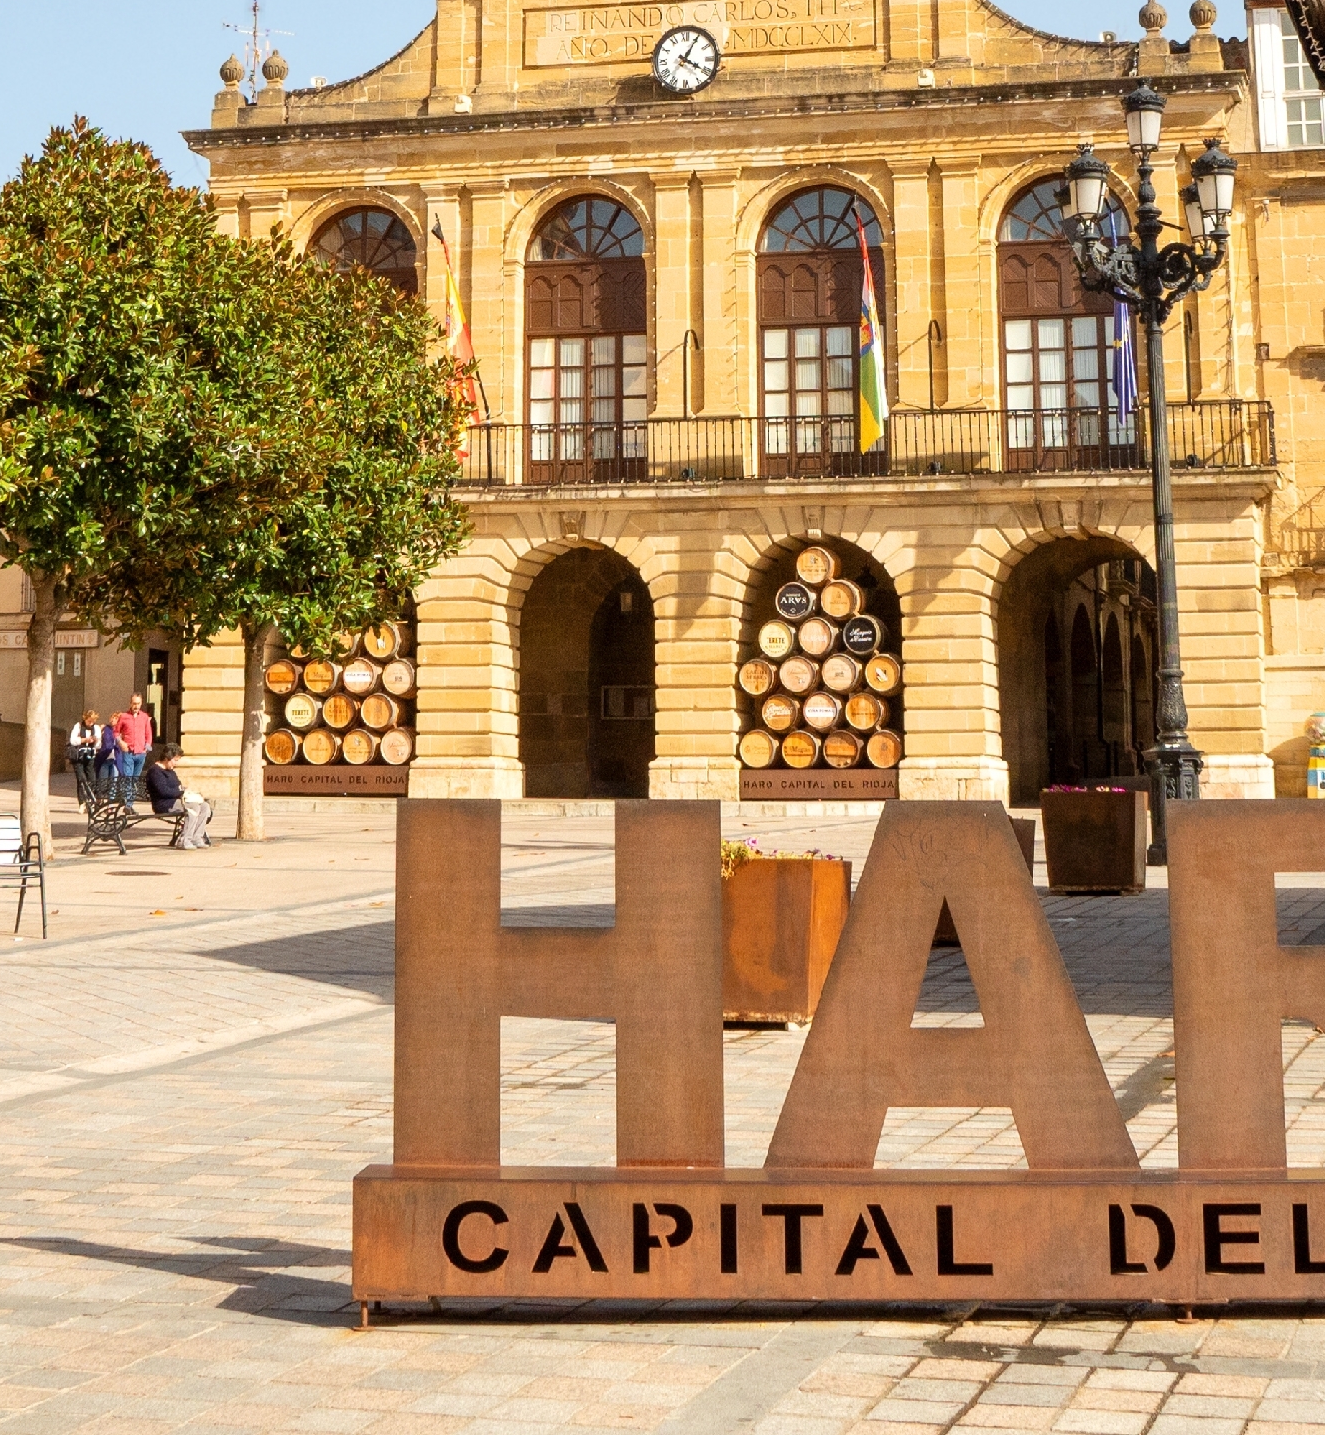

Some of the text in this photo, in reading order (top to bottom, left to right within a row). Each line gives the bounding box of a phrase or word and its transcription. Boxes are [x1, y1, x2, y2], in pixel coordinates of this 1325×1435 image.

[550, 5, 685, 32] REINANDO
[624, 34, 654, 56] DE
[266, 775, 405, 785] HARO CAPITAL DEL RIOJA
[743, 780, 895, 789] HARO CAPITAL DEL RIOJA
[442, 1199, 994, 1277] CAPITAL
